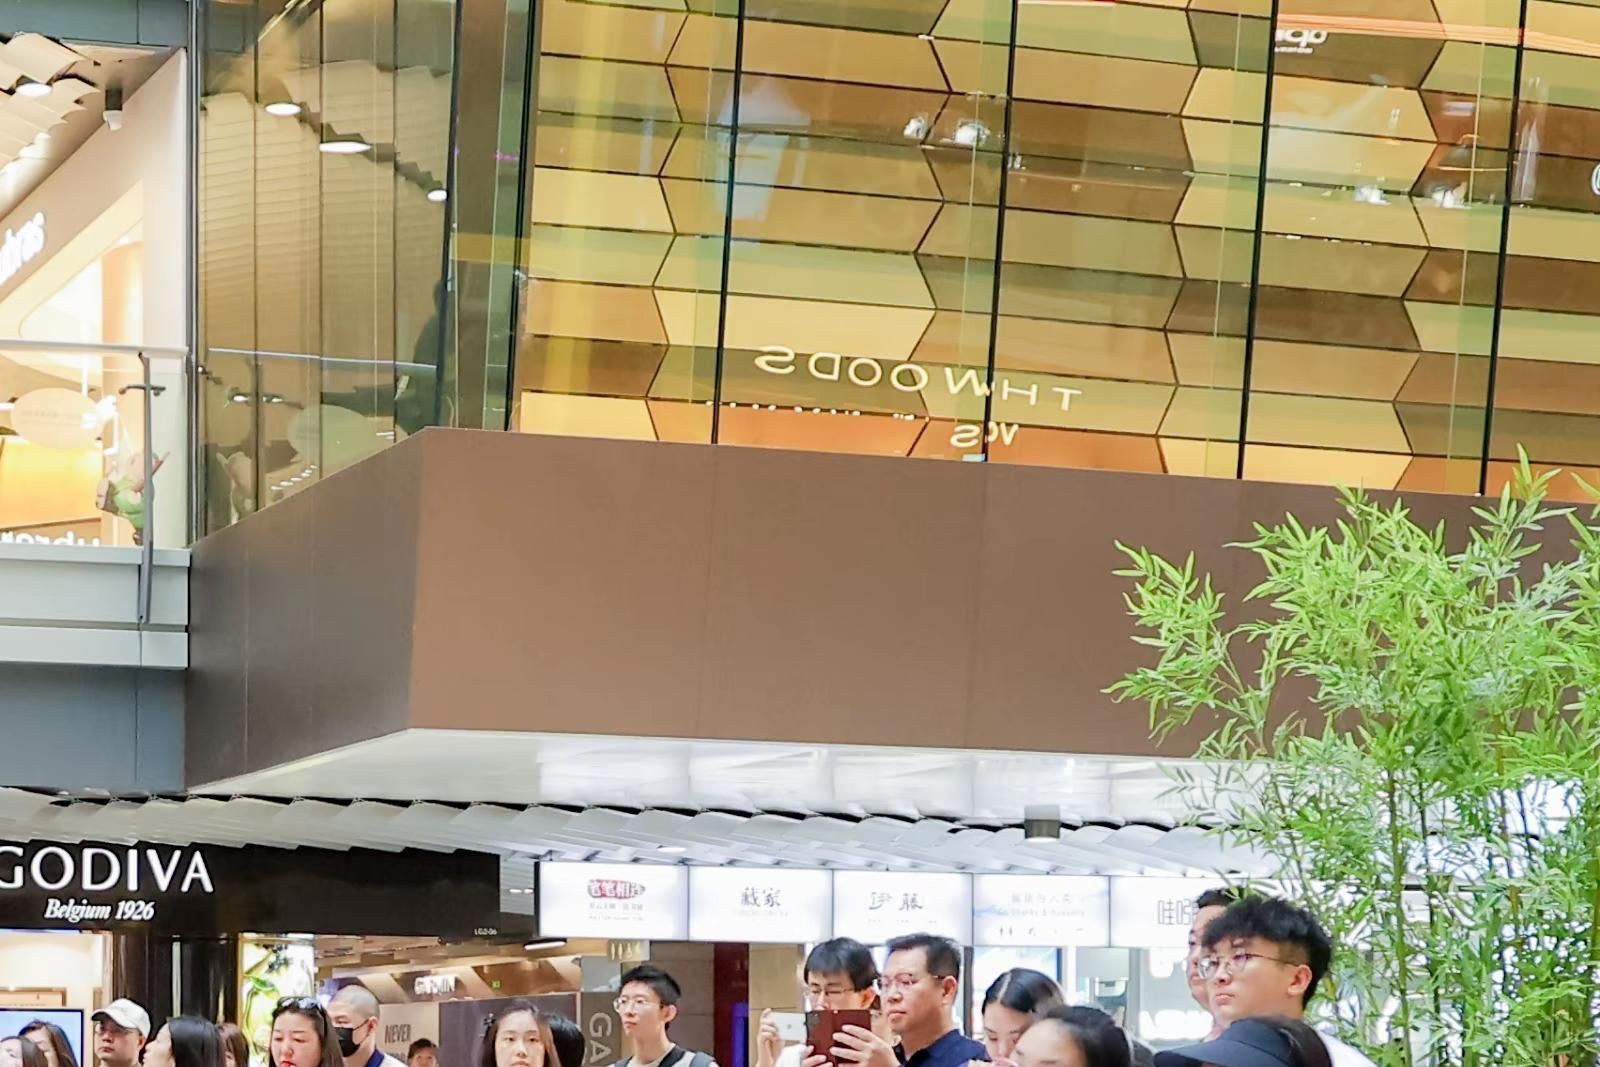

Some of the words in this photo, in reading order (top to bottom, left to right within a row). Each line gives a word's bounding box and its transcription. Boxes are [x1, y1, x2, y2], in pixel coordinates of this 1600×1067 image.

[44, 898, 111, 922] Belgium
[114, 900, 155, 920] 1926
[384, 1023, 412, 1044] NEVER
